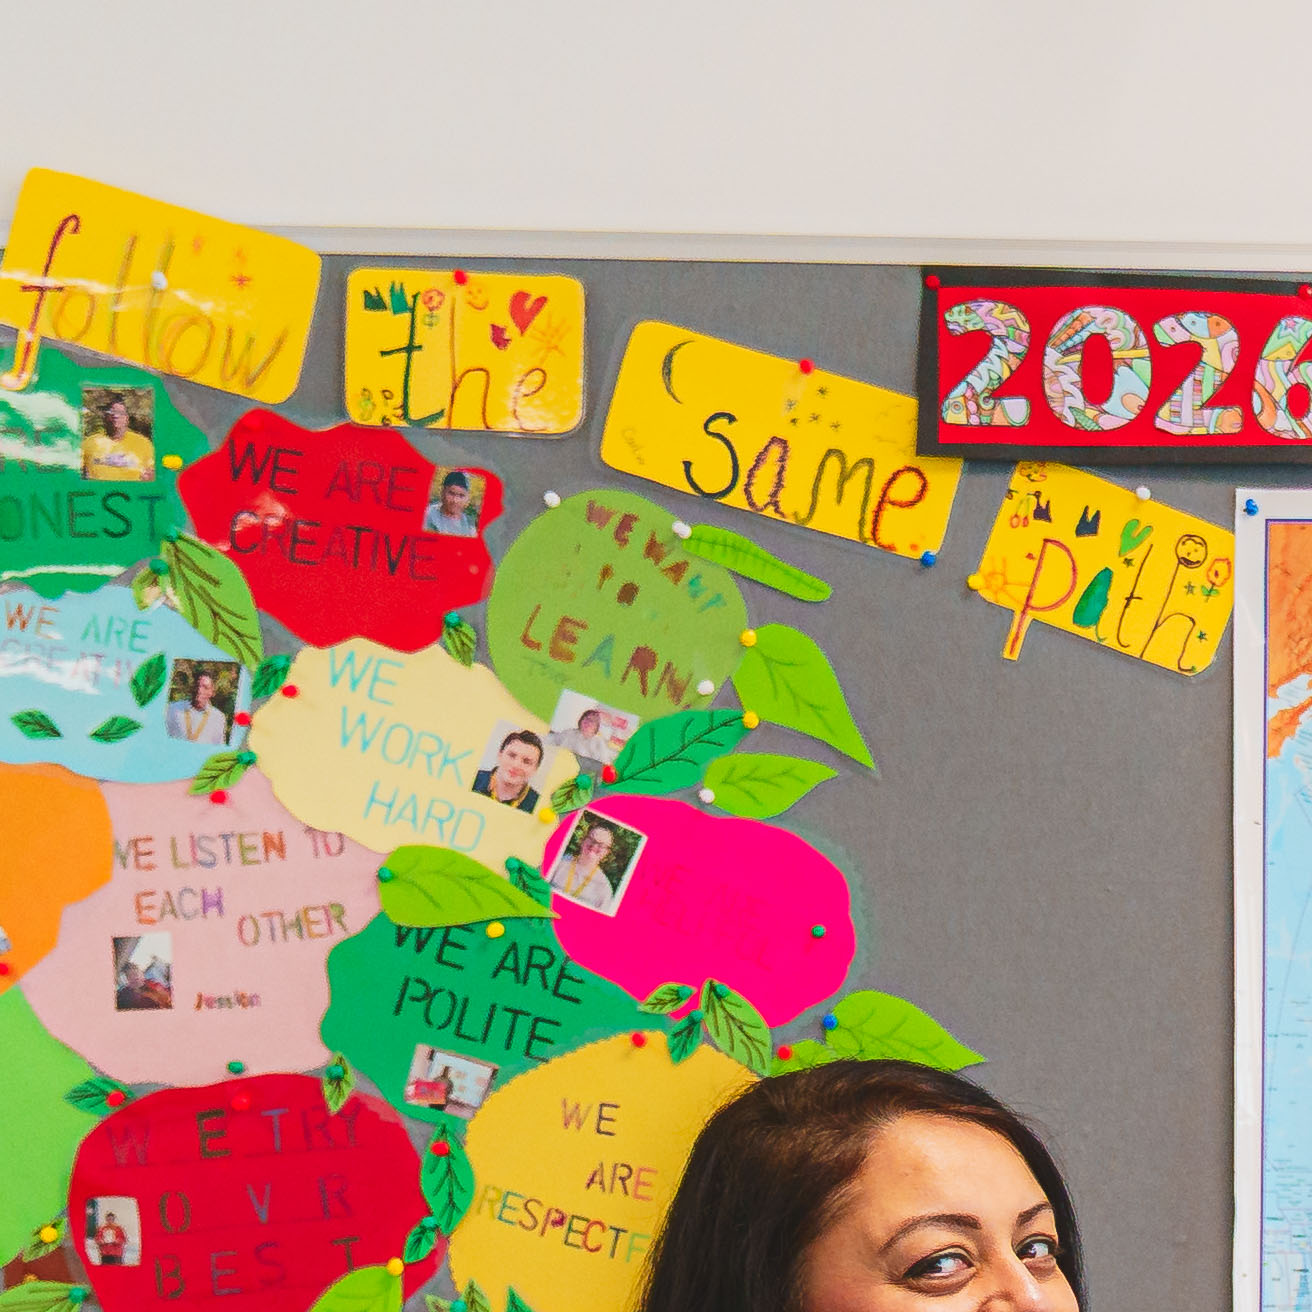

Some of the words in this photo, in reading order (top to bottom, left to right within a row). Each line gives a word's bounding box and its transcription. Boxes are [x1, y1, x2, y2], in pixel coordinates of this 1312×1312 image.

[0, 214, 289, 389] follow
[380, 292, 547, 430] the
[230, 440, 303, 495] WE
[326, 464, 417, 512] ARE
[0, 488, 165, 541] ONEST
[230, 511, 439, 581] CREATIVE
[585, 499, 640, 550] WE
[4, 601, 61, 641] WE
[81, 614, 152, 653] ARE
[1007, 538, 1199, 673] path
[330, 649, 405, 706] WE
[340, 706, 473, 787] WORK
[171, 830, 287, 869] LISTEN
[308, 829, 347, 859] TO
[364, 779, 486, 853] HARD
[134, 886, 225, 926] EACH
[237, 903, 348, 948] OTHER
[395, 923, 475, 972] WE
[492, 942, 586, 1005] ARE
[395, 976, 561, 1063] POLITE
[108, 1108, 232, 1167] WE
[259, 1105, 366, 1153] TRY
[561, 1097, 618, 1138] WE
[586, 1161, 659, 1201] ARE
[476, 1184, 651, 1264] RESPECTF
